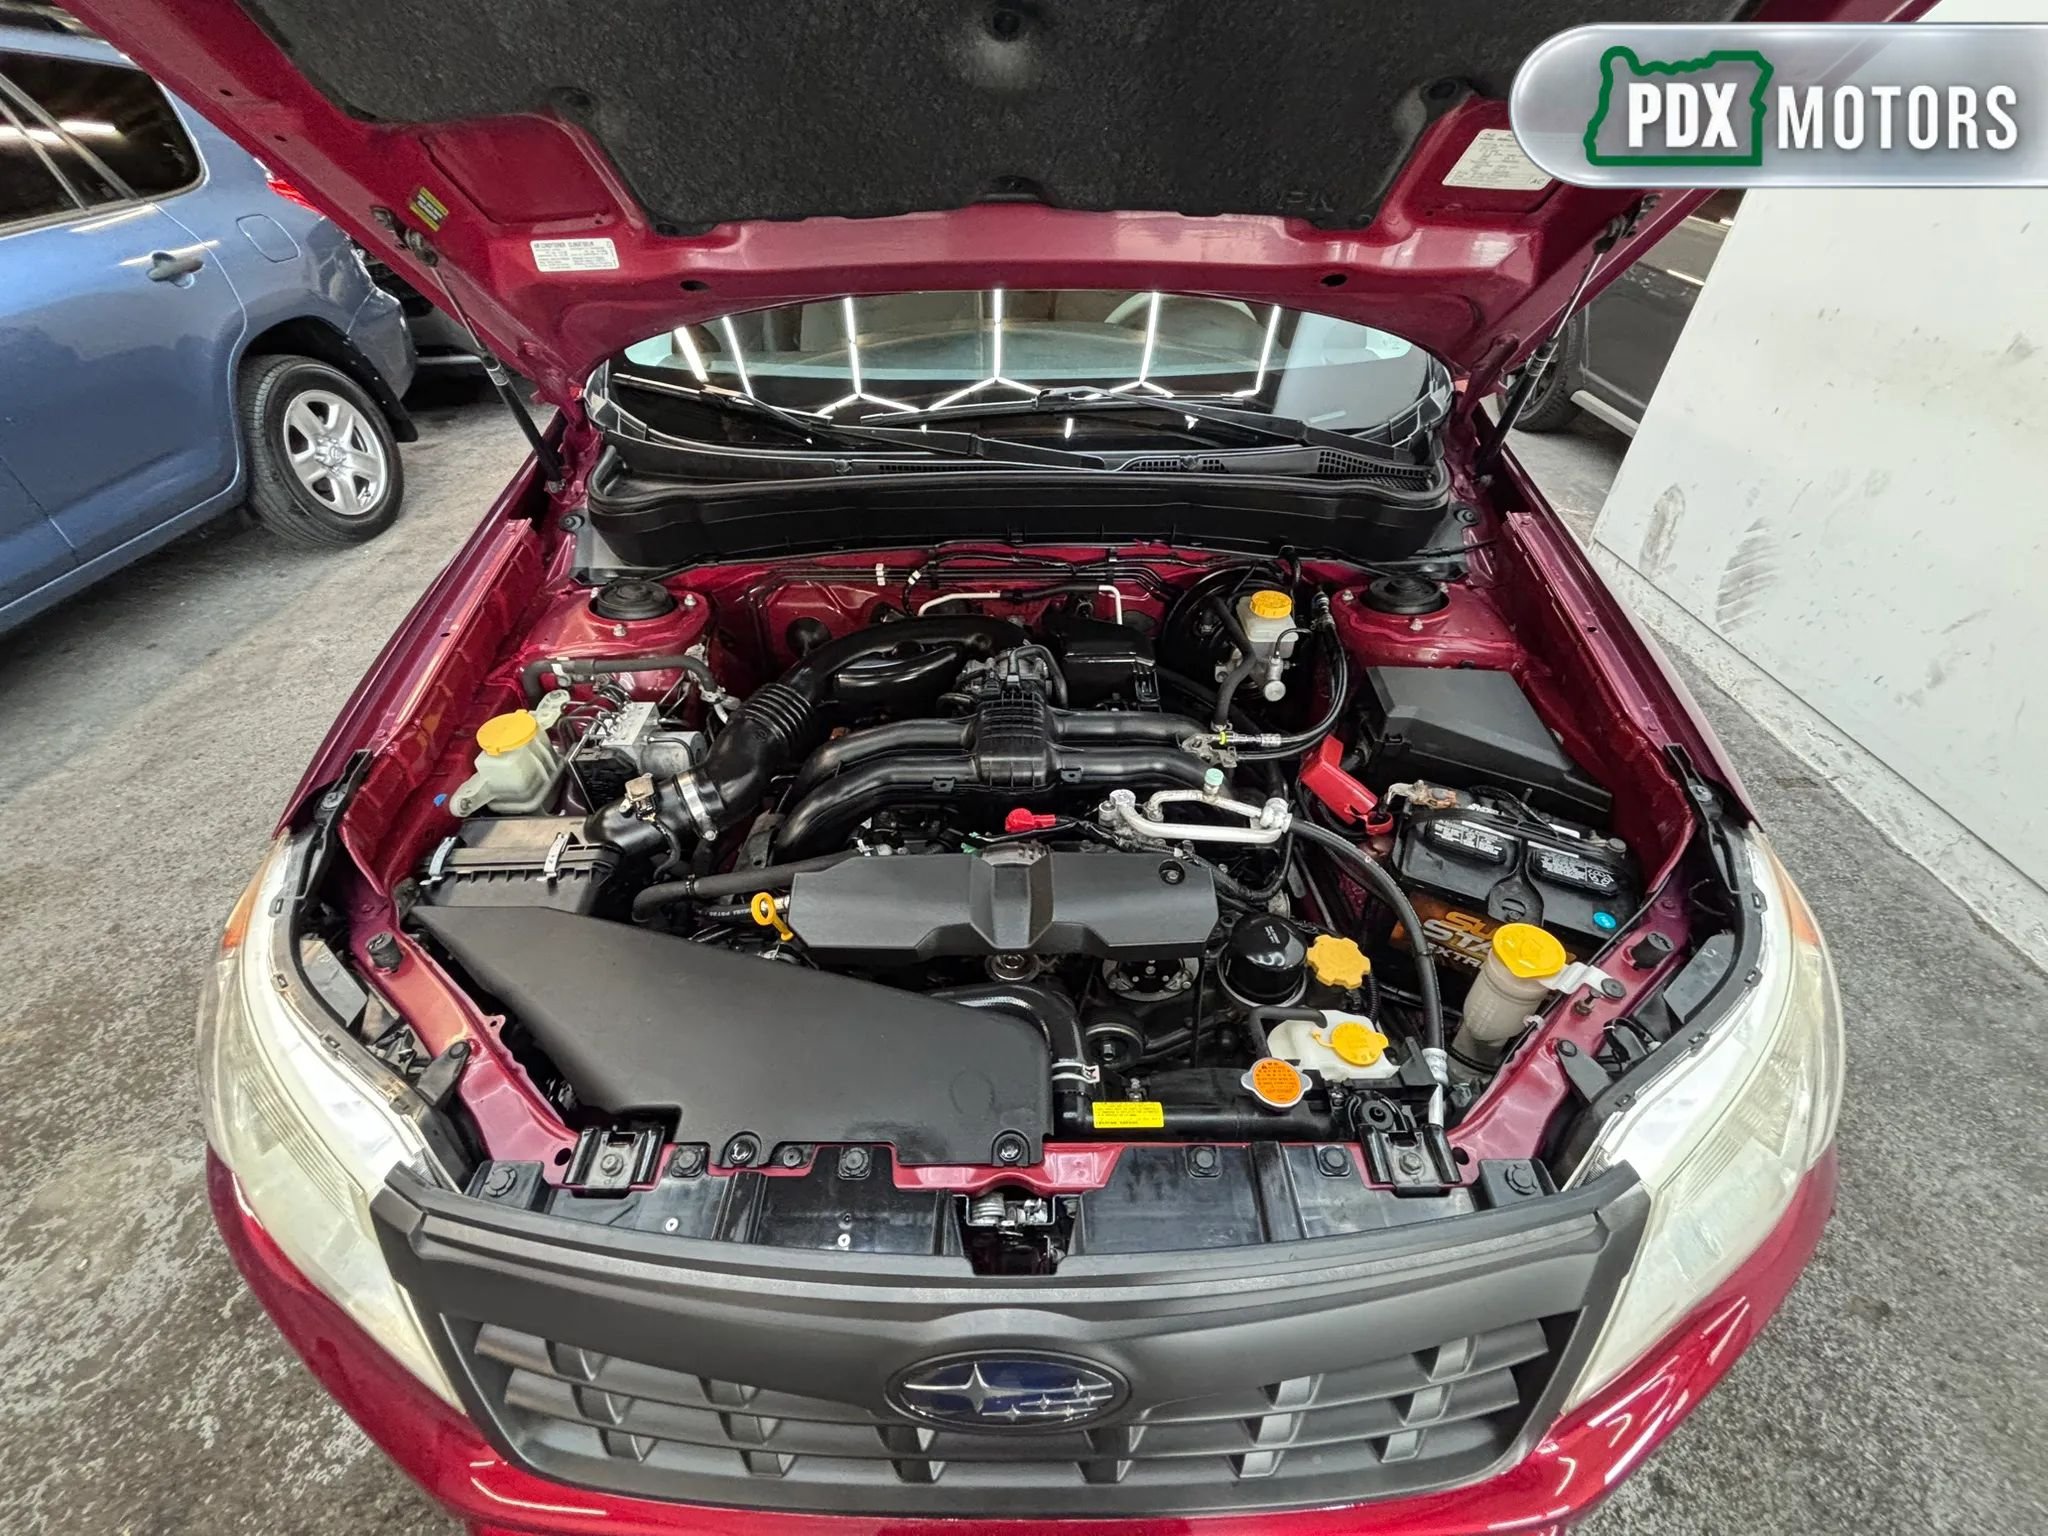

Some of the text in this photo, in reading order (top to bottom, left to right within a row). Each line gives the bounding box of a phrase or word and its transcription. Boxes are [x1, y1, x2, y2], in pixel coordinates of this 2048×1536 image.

[1423, 918, 1492, 952] STA
[1440, 911, 1497, 940] SU
[1427, 942, 1482, 968] EXTR
